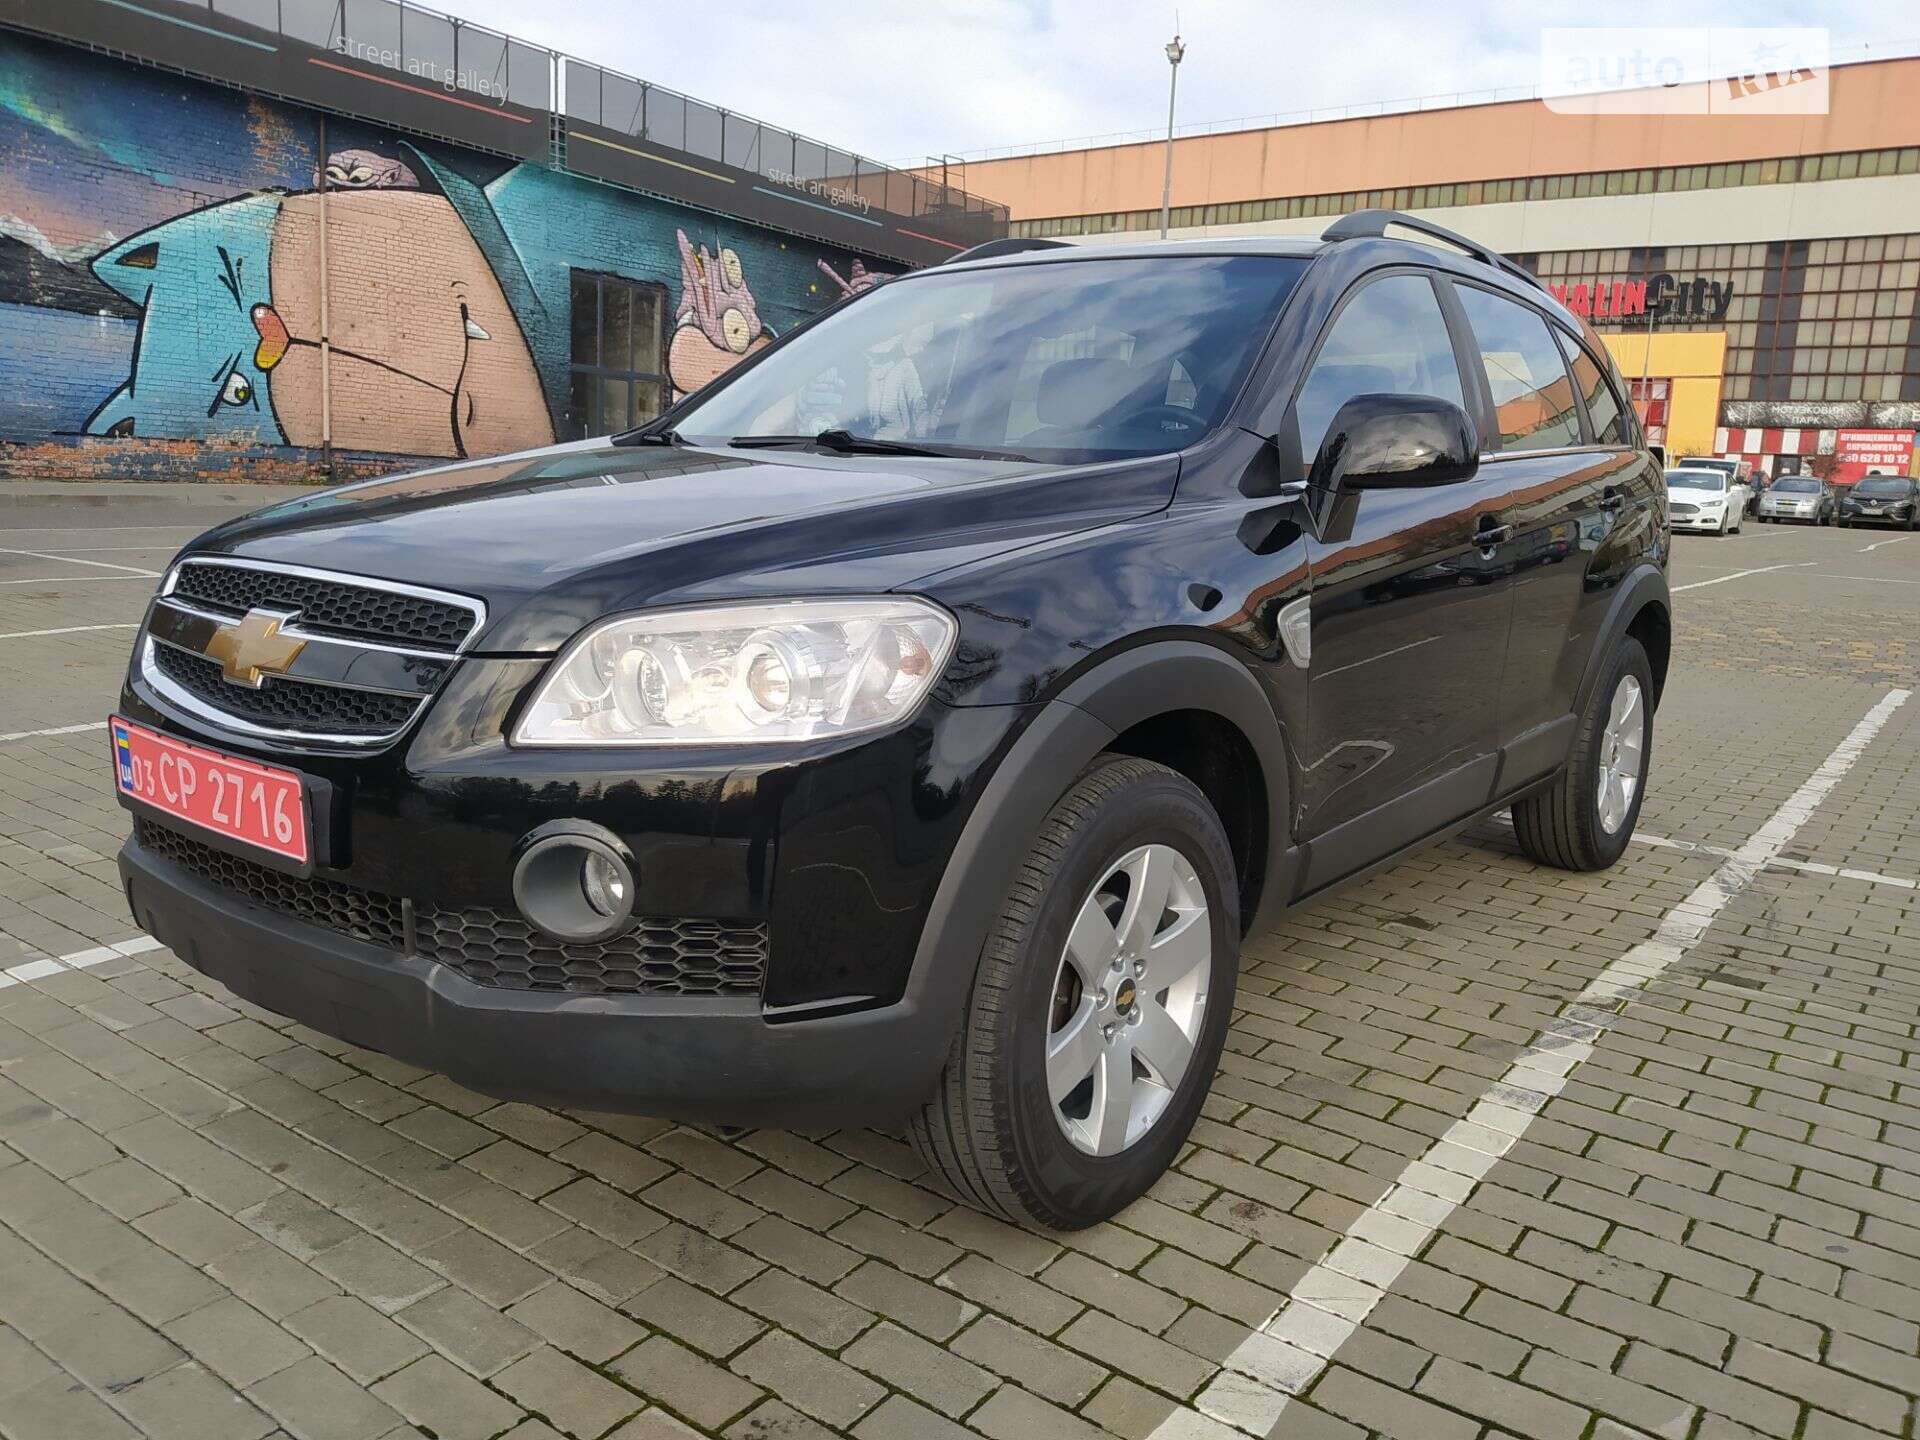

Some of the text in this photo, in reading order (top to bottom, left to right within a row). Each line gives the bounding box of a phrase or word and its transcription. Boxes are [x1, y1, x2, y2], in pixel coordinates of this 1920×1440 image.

[336, 35, 510, 106] street art gallery
[768, 168, 870, 214] street art gallery
[1792, 416, 1820, 425] ПАРК
[1860, 453, 1881, 463] 628
[1896, 454, 1909, 464] 12
[121, 763, 132, 783] UA
[132, 752, 293, 844] 03 CP 2716
